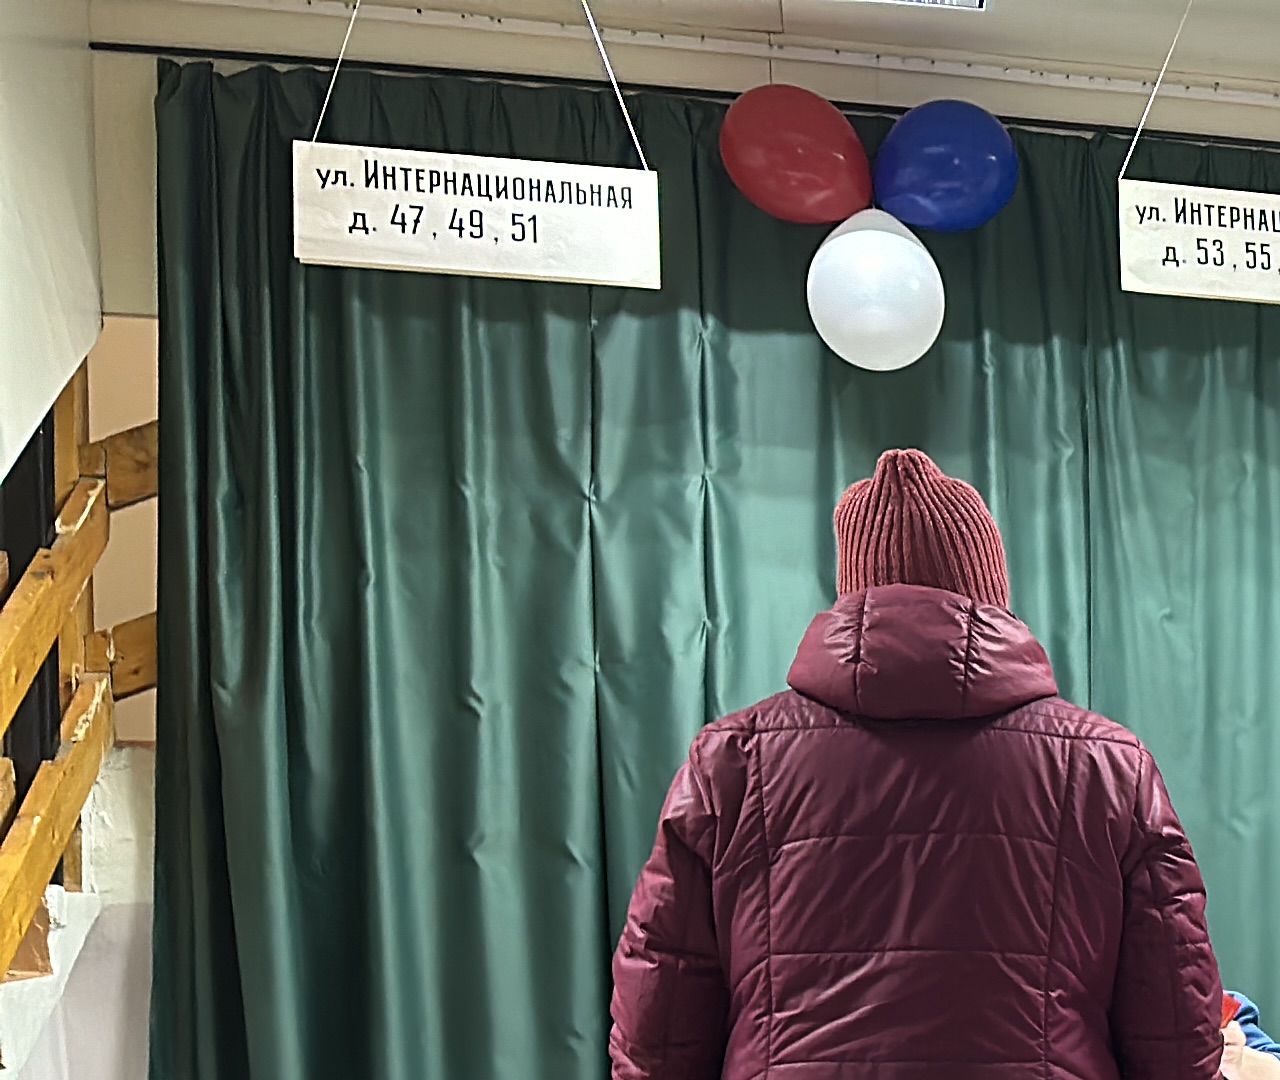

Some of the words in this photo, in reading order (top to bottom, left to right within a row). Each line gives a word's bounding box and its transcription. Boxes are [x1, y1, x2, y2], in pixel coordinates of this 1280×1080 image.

[315, 166, 356, 190] ул.
[363, 159, 634, 211] ИНТЕРНАЦИОНАЛЬНАЯ
[348, 210, 378, 236] д.
[510, 213, 540, 245] 51
[1134, 204, 1167, 225] ул.
[1161, 245, 1188, 268] д.
